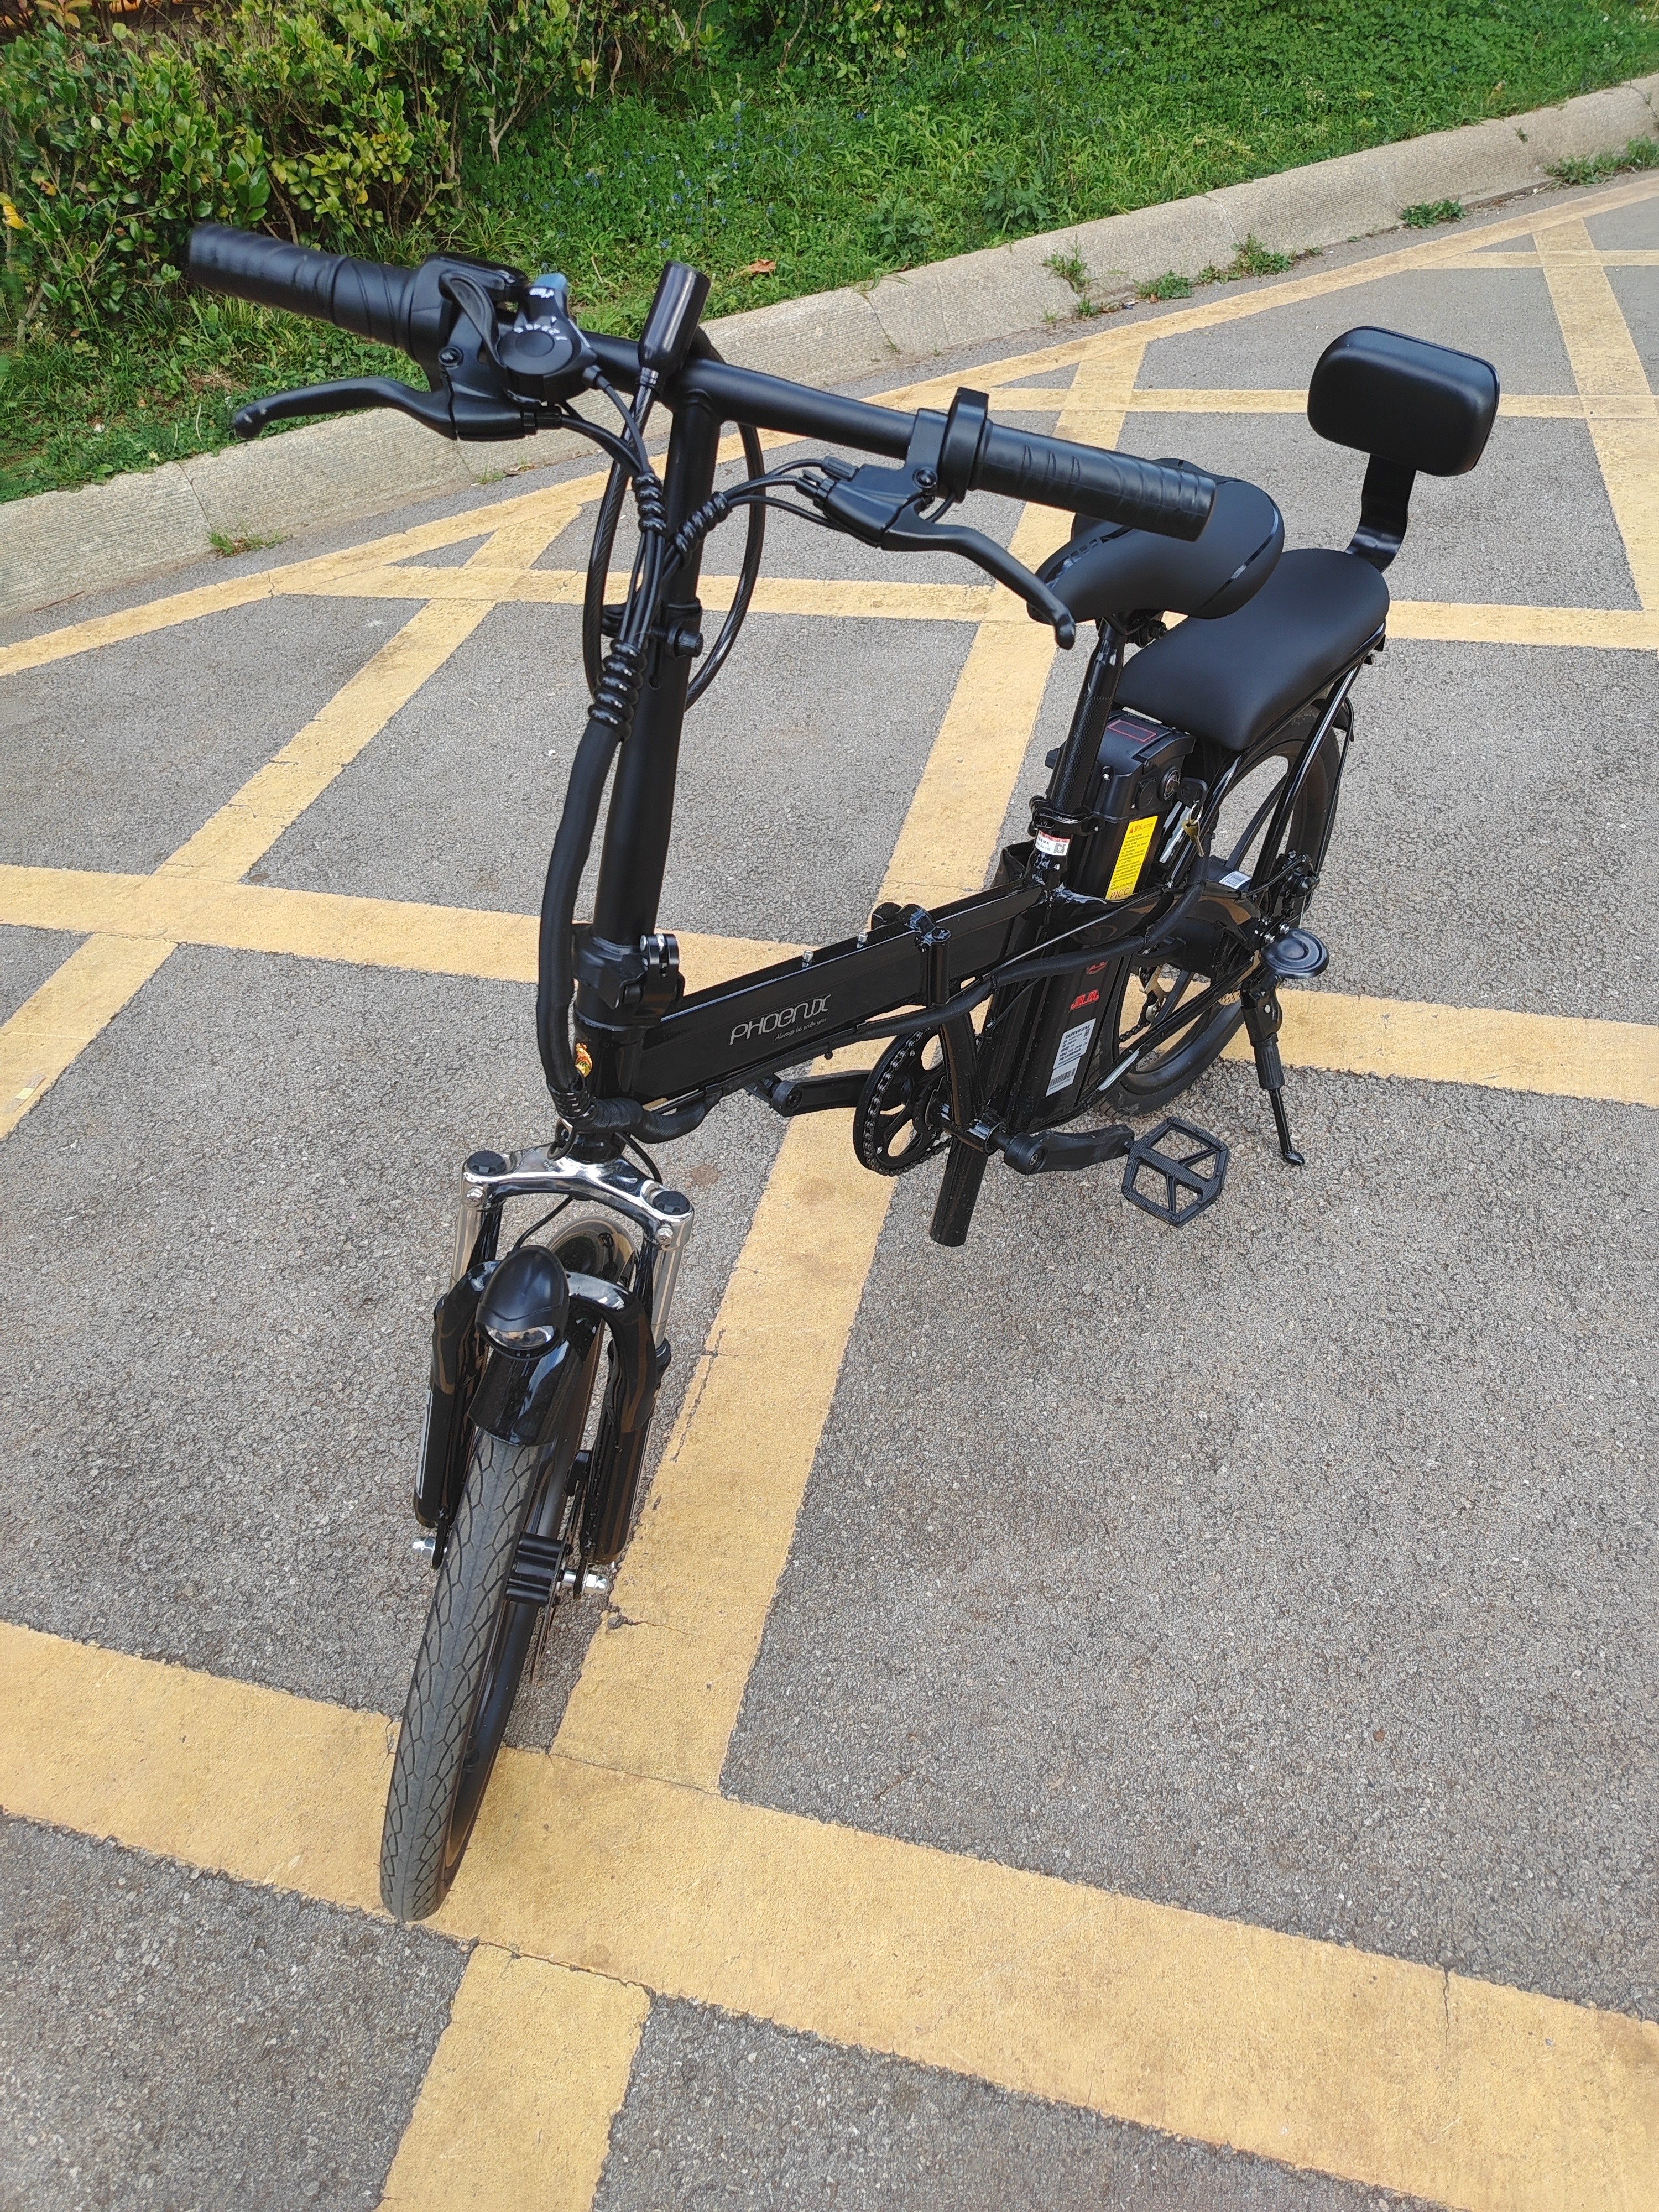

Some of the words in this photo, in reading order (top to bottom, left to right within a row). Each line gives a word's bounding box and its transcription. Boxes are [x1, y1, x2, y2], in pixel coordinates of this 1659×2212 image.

[1110, 887, 1130, 900] PICC
[774, 1029, 795, 1041] Always
[803, 1020, 817, 1030] with
